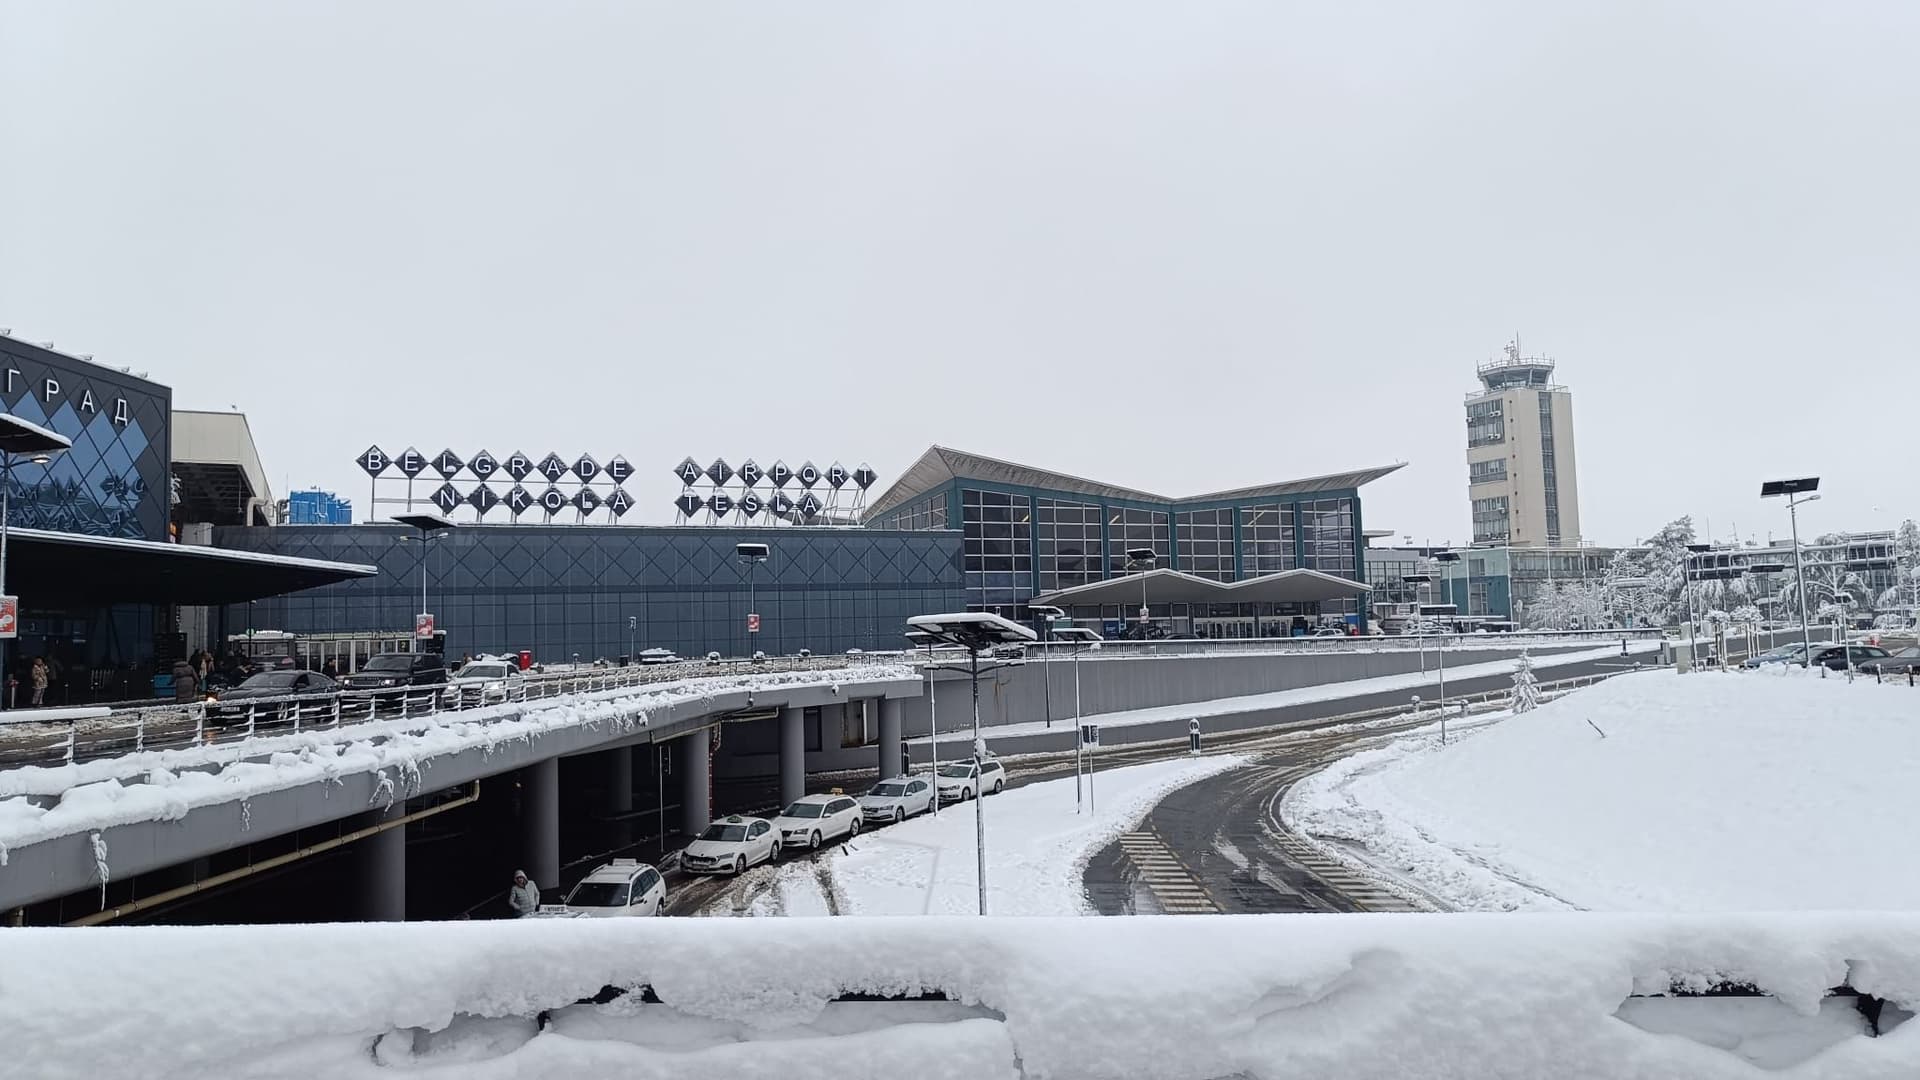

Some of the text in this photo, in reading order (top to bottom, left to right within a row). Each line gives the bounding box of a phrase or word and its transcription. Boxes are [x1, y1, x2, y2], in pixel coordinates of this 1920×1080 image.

[7, 368, 128, 426] ГРАД
[367, 453, 871, 485] BELGRADE AIRPORT
[440, 489, 817, 513] NIKOLA TESLA
